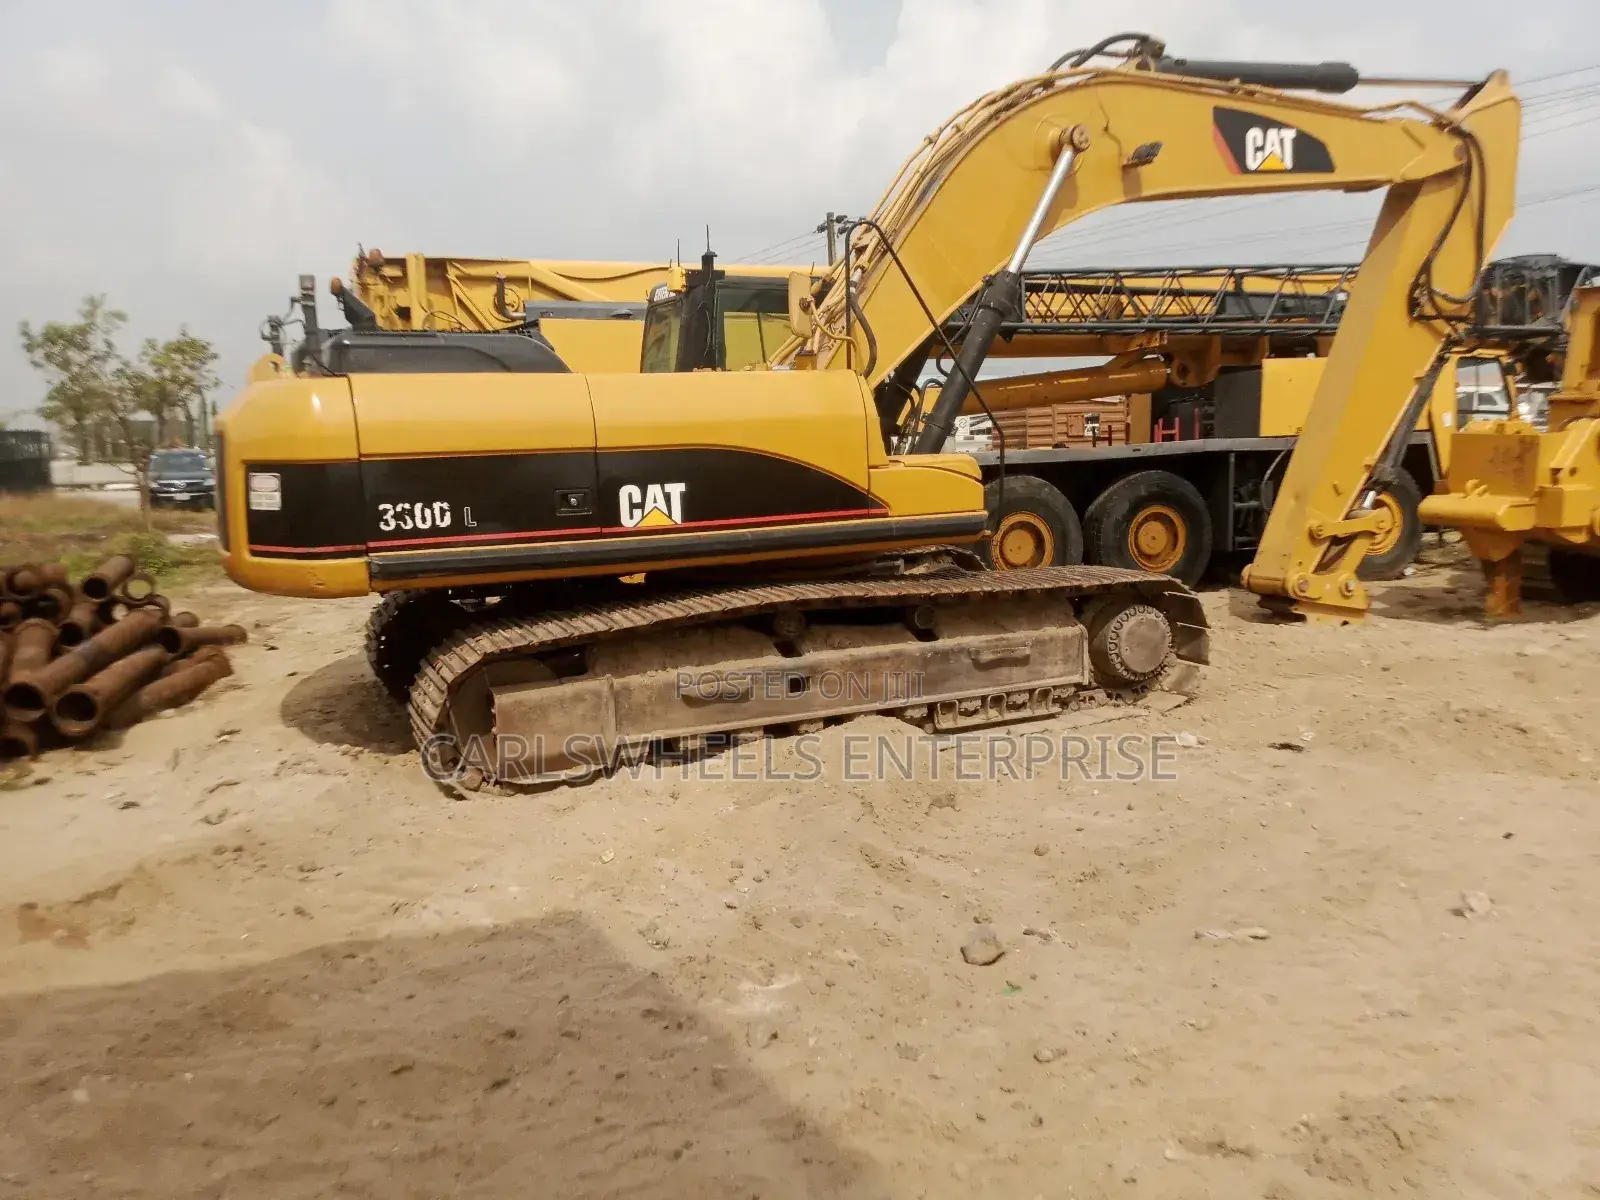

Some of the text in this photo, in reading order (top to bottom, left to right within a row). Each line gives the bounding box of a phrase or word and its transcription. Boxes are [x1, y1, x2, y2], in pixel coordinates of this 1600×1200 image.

[1245, 127, 1297, 171] CAT
[463, 506, 478, 527] L
[619, 482, 686, 528] CAT
